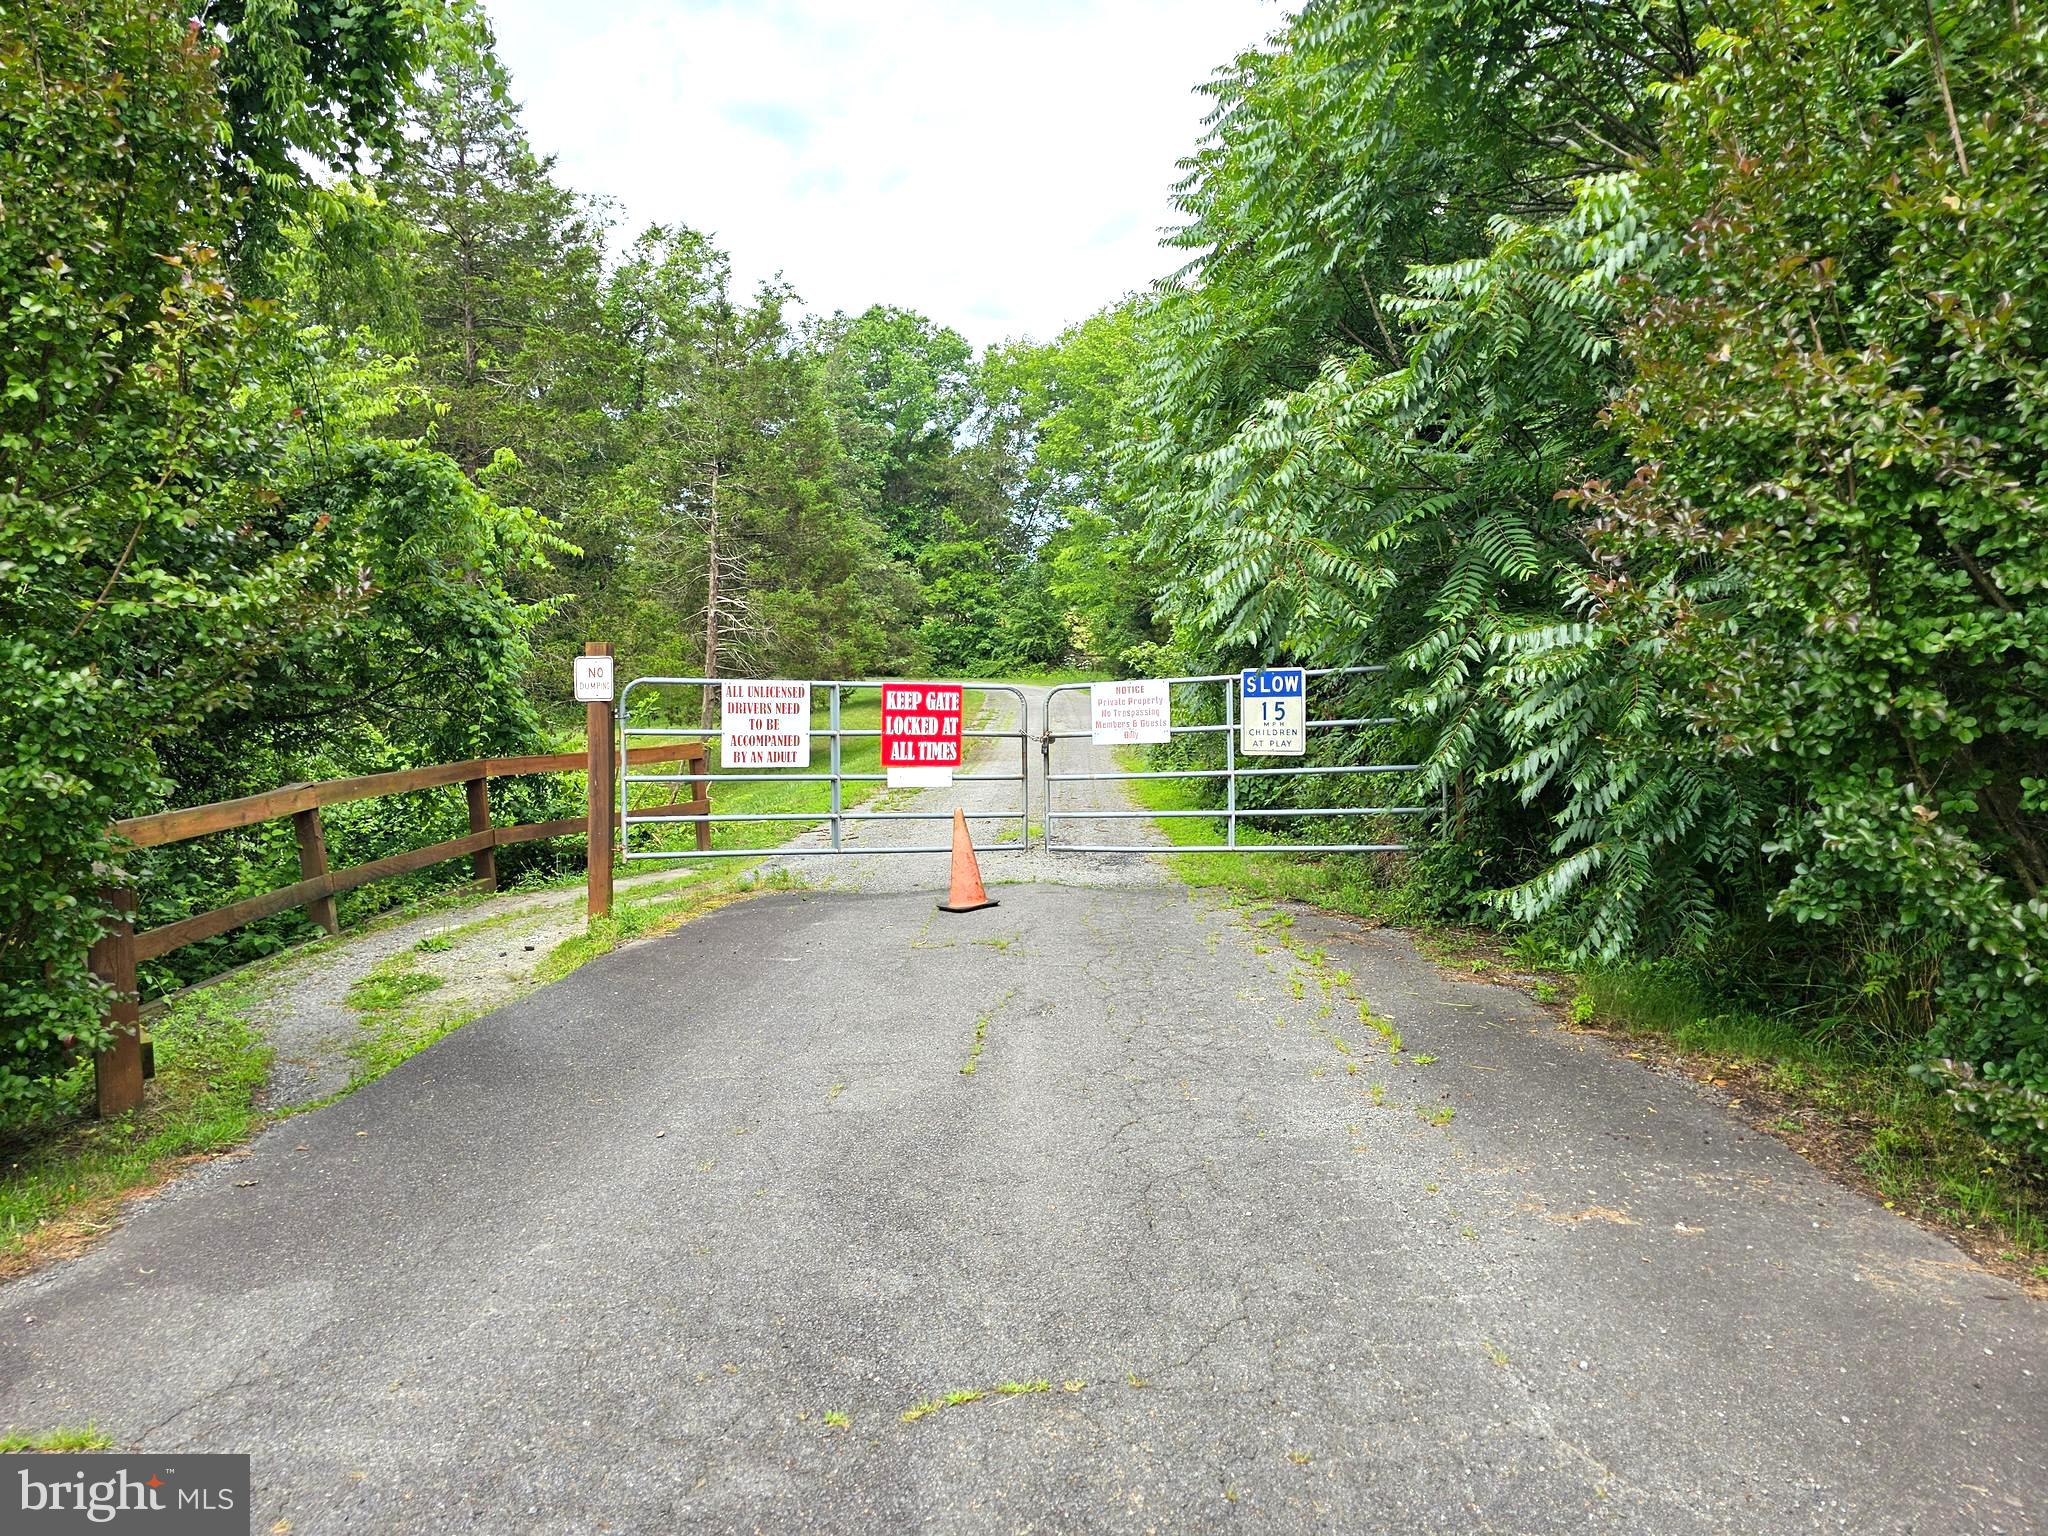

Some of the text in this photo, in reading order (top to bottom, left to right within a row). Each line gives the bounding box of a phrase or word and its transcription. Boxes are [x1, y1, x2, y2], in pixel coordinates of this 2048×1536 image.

[588, 667, 603, 678] NO
[580, 682, 610, 690] DUMPING
[1115, 685, 1145, 695] NOTICE
[1246, 675, 1299, 693] SLOW
[726, 685, 805, 698] ALL UNLICENSED
[886, 690, 960, 711] KEEP GATE
[1097, 696, 1163, 706] Private Property
[727, 702, 801, 714] DRIVERS NEED
[1101, 708, 1160, 718] No Trespassing
[1262, 701, 1286, 721] 15
[749, 718, 780, 730] TO BE
[885, 716, 959, 736] LOCKED AT
[1095, 720, 1130, 728] Members
[1140, 719, 1167, 728] Guests
[1248, 728, 1298, 736] CHILDREN
[730, 734, 801, 747] ACCOMPANIED
[890, 741, 957, 760] ALL TIMES
[733, 751, 798, 763] BY AN ADULT
